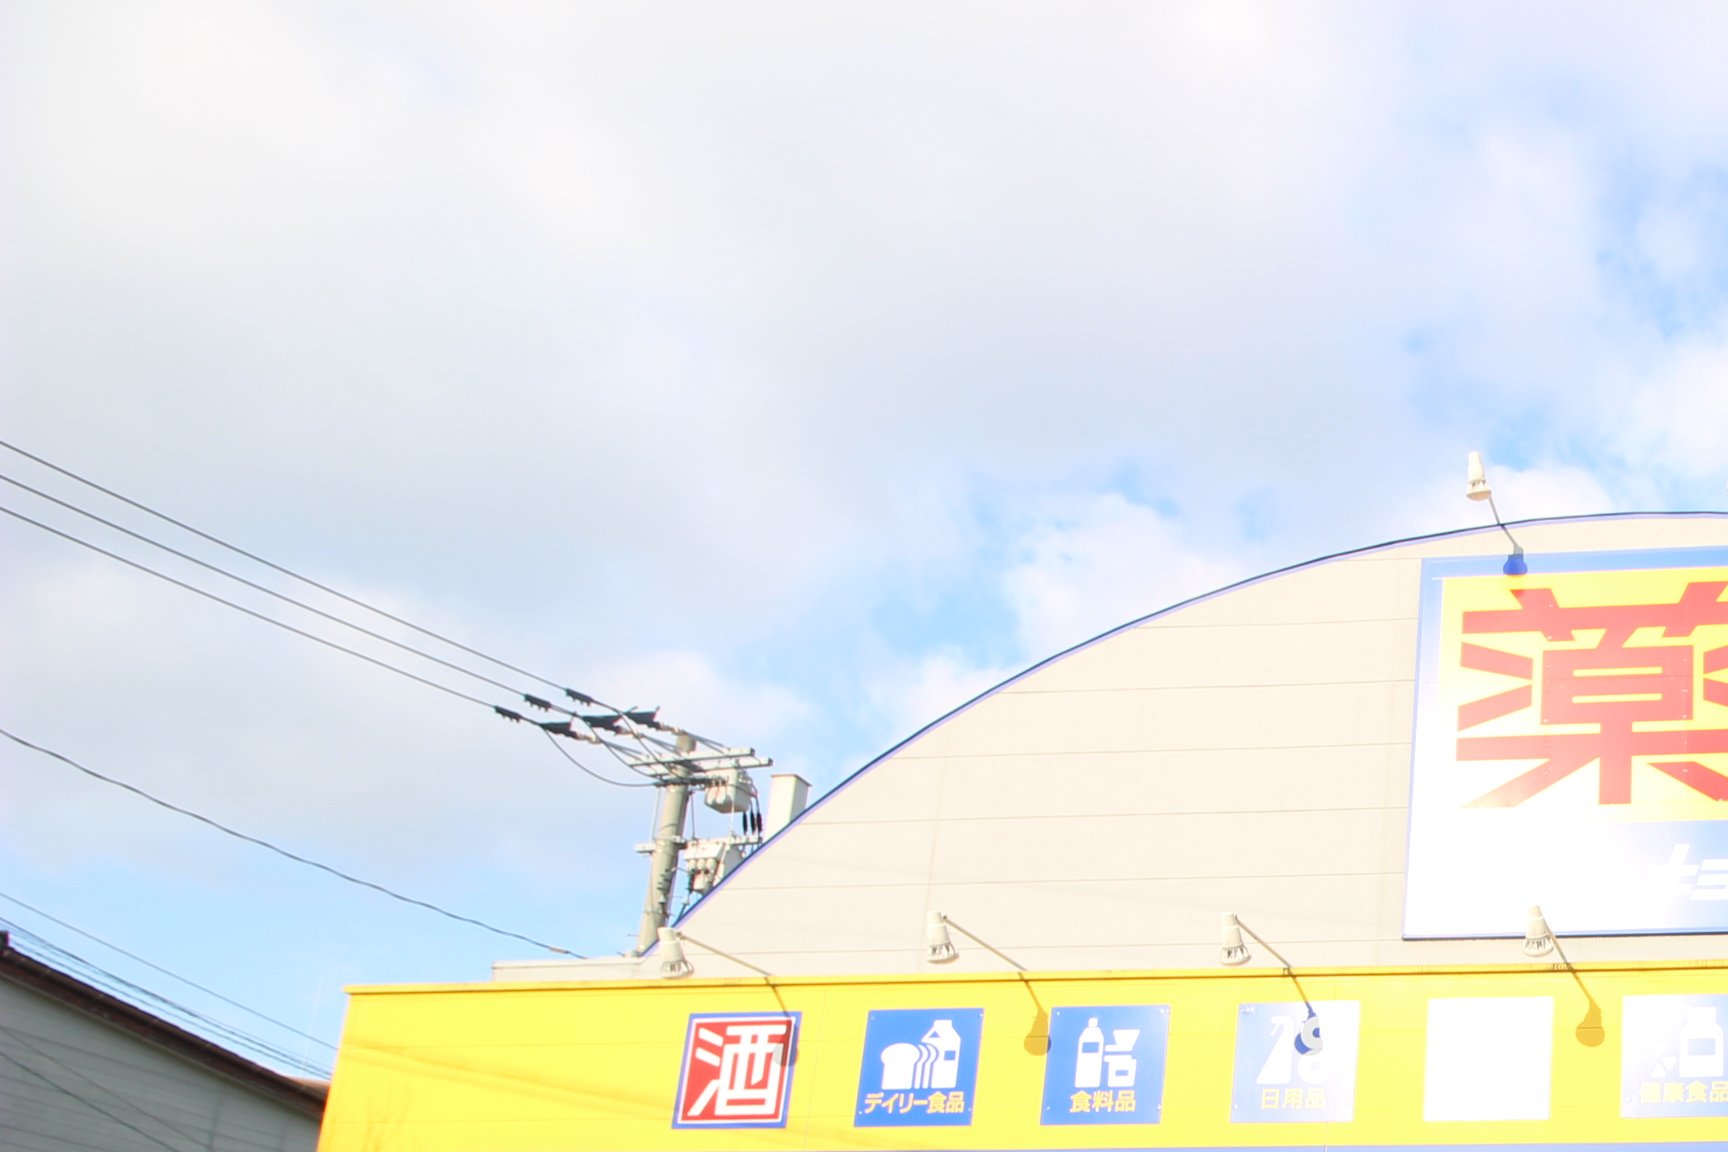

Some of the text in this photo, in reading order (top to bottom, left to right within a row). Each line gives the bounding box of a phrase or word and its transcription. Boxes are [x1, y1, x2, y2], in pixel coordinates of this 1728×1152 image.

[687, 1024, 788, 1117] 酒
[864, 1090, 965, 1115] デイリー食品
[1070, 1089, 1137, 1114] 食料品
[1261, 1087, 1326, 1110] 日用品
